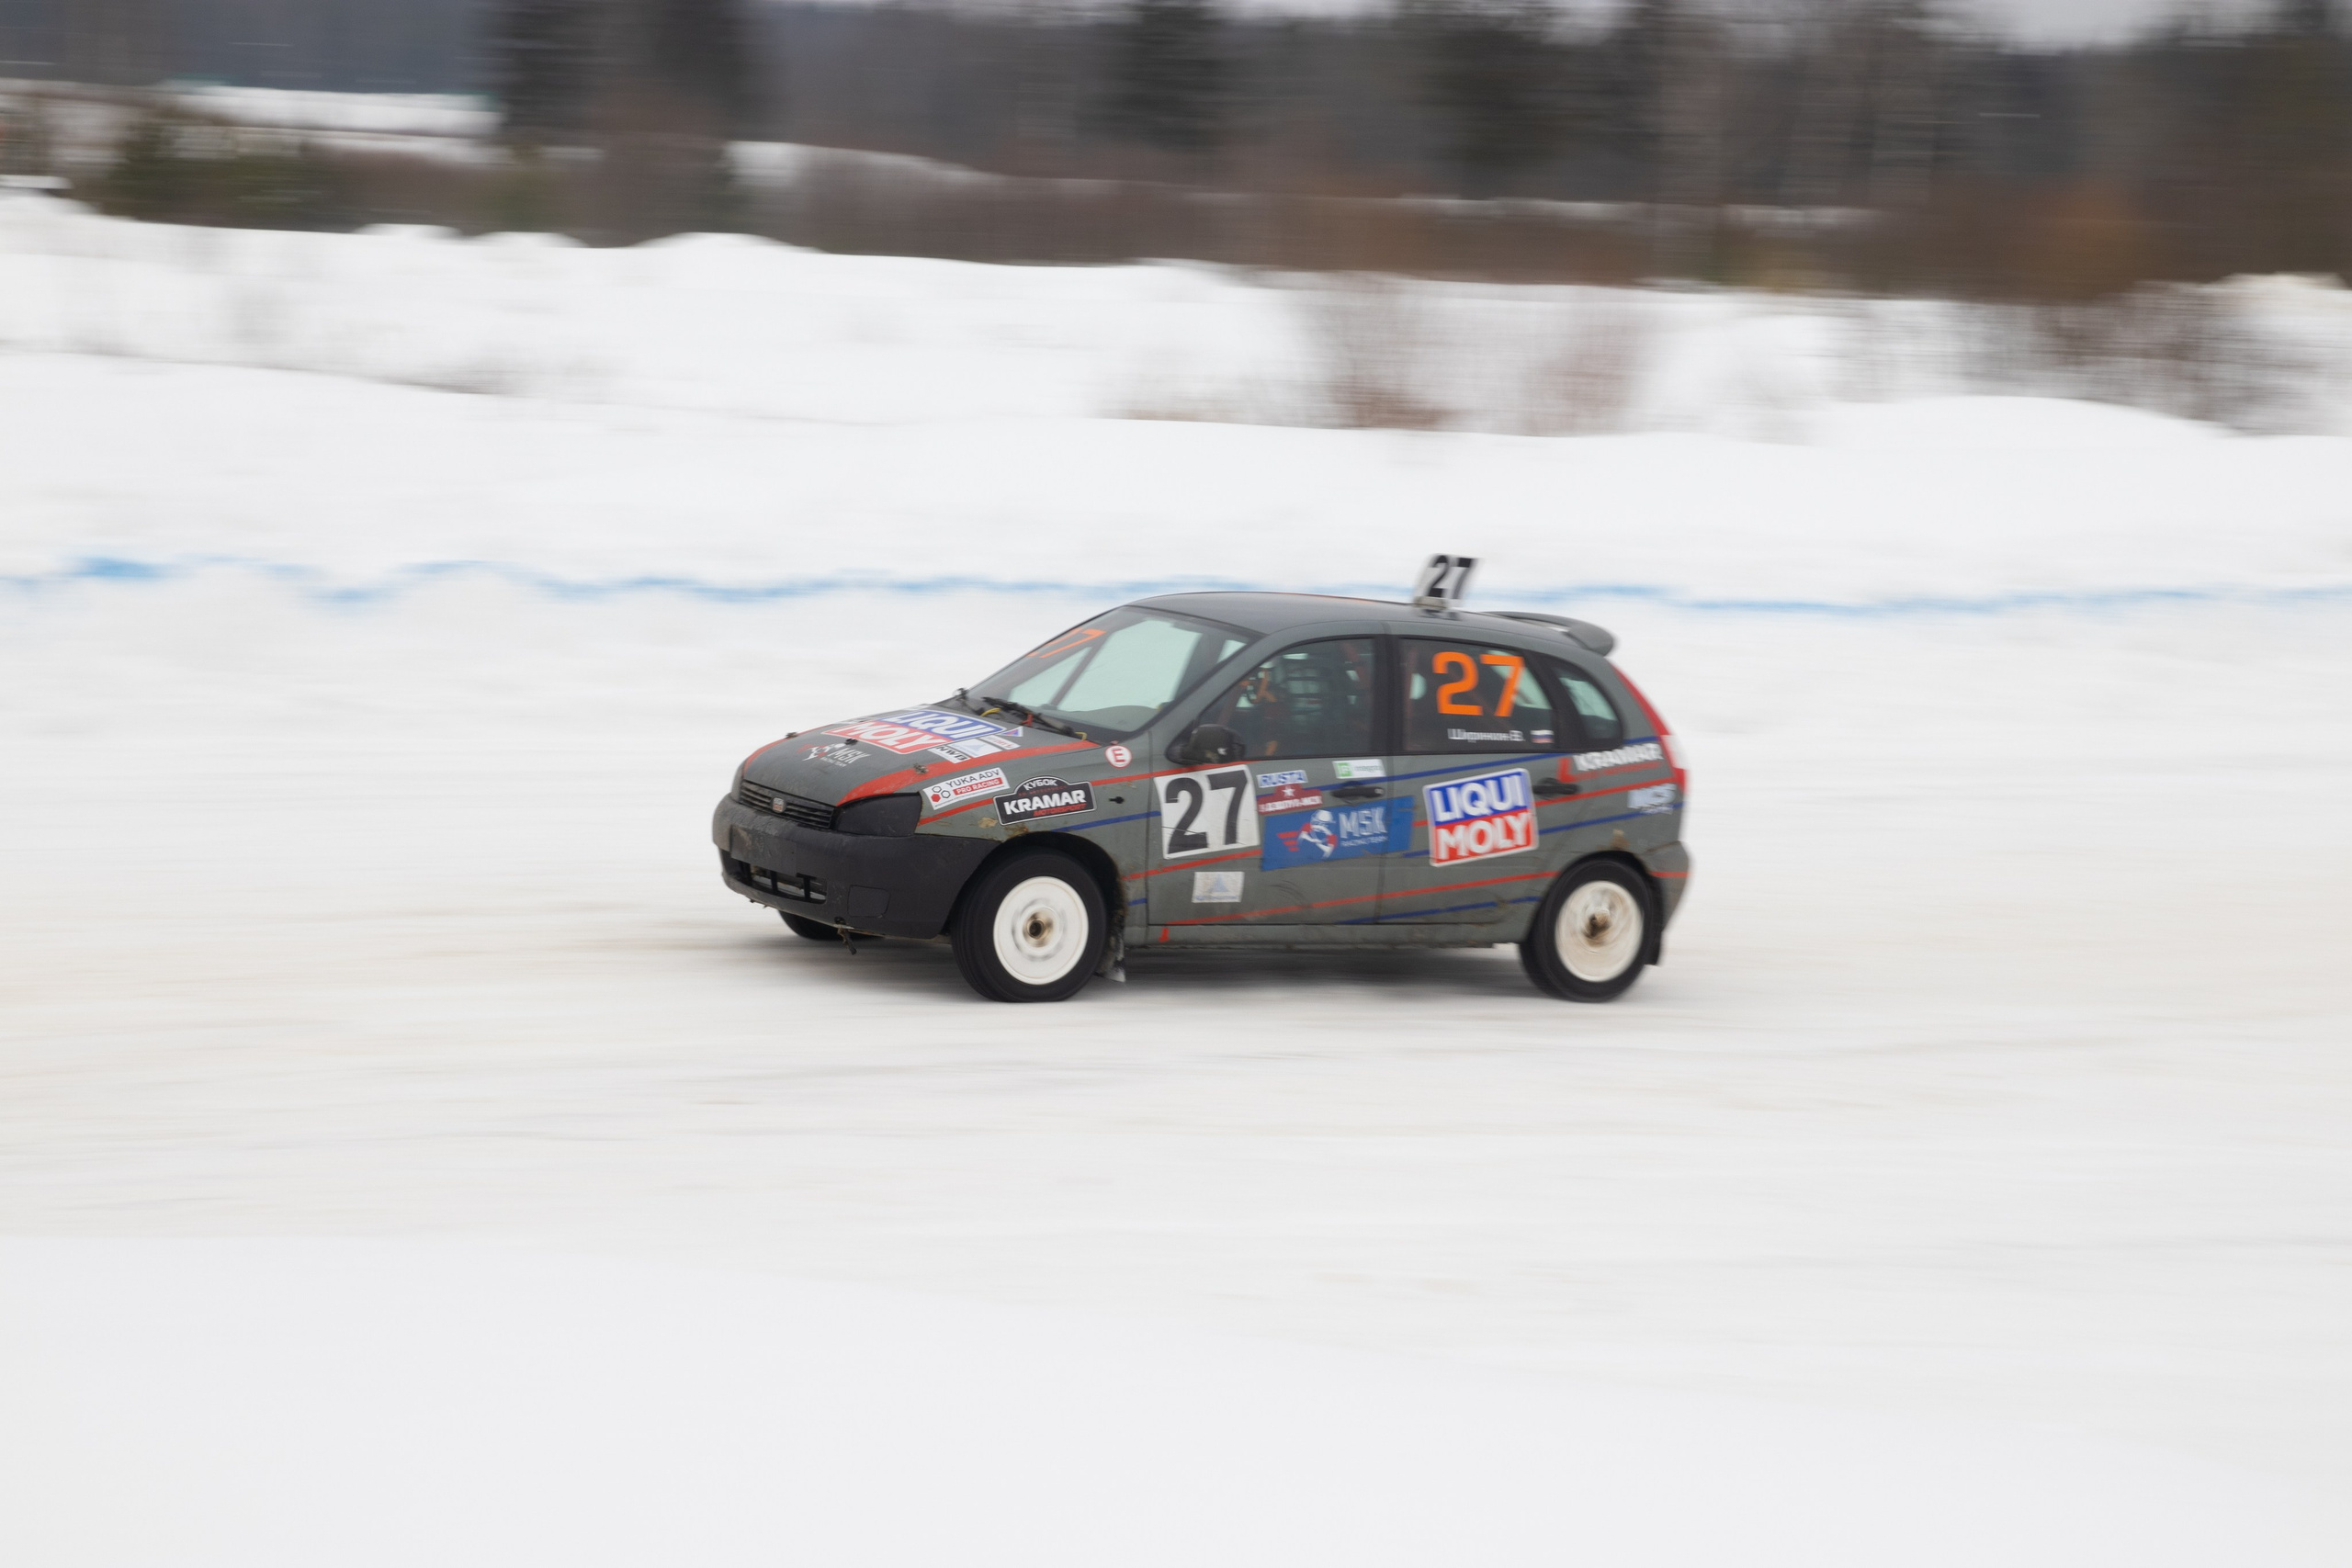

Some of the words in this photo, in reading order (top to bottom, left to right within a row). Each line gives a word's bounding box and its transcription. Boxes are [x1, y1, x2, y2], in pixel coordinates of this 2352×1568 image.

[1427, 555, 1476, 599] 27
[1431, 651, 1525, 717] 27
[832, 721, 950, 750] MOLY
[889, 711, 997, 739] LIQUI
[827, 747, 872, 764] MSK
[1112, 749, 1125, 763] E
[1573, 742, 1664, 771] KRAMAR
[945, 775, 977, 788] YUKA
[978, 770, 1001, 780] ADV
[972, 779, 1001, 790] RACING
[1023, 779, 1057, 791] КУБОК
[1003, 789, 1087, 815] KRAMAR
[1033, 803, 1088, 817] MOTORSPORT
[1165, 769, 1248, 854] 27
[1430, 773, 1528, 822] LIQUI
[1339, 807, 1387, 839] MSK
[1437, 812, 1532, 861] MOLY
